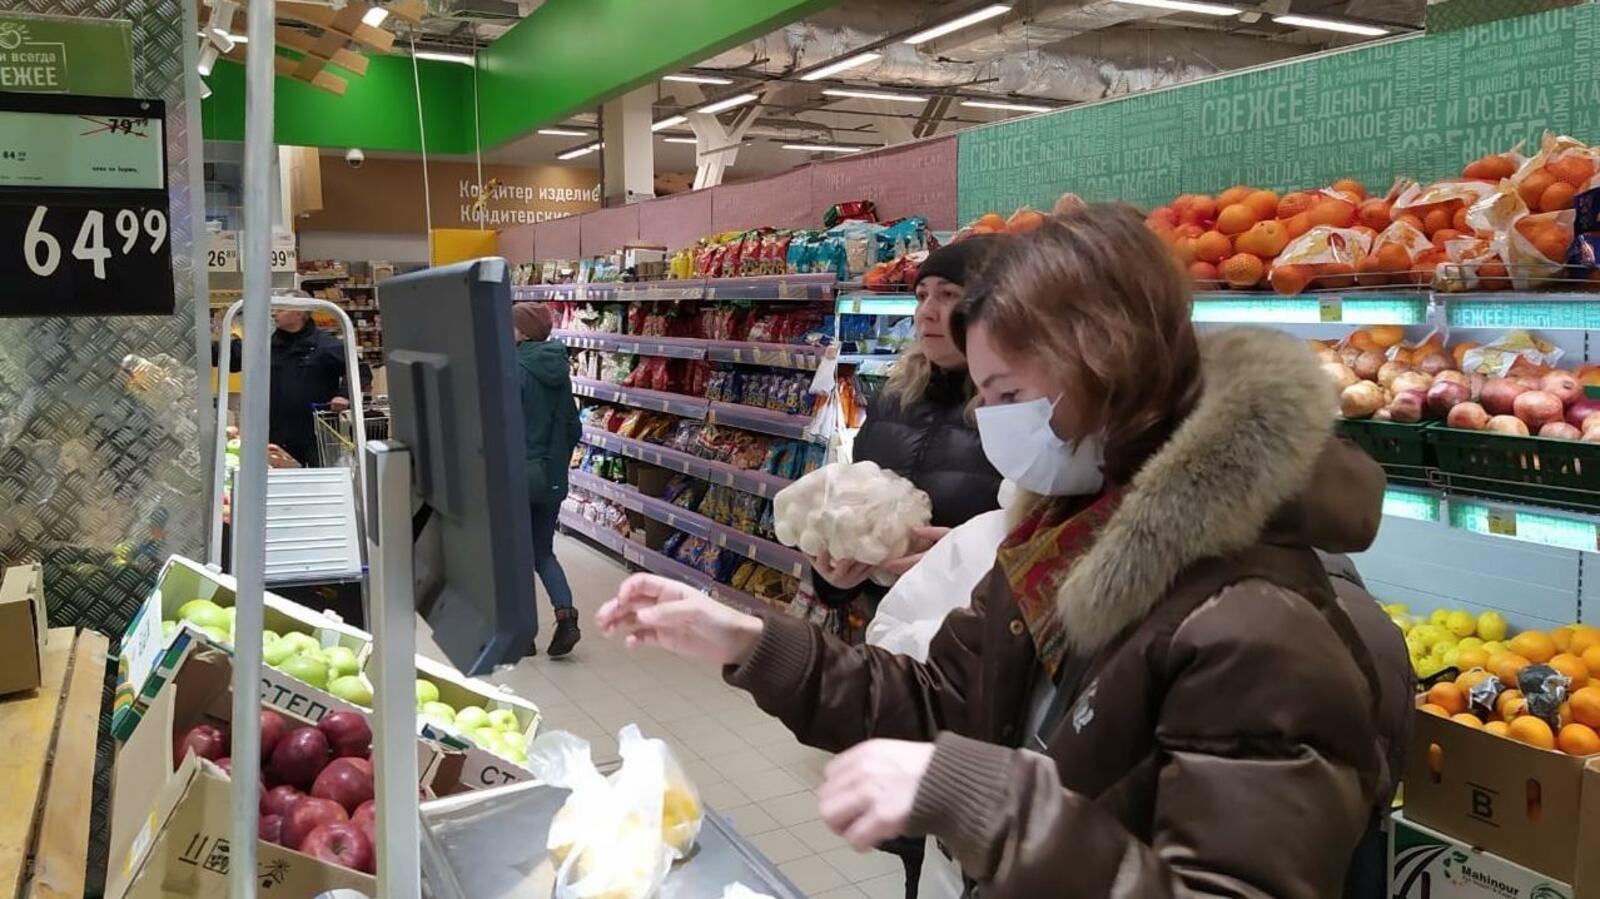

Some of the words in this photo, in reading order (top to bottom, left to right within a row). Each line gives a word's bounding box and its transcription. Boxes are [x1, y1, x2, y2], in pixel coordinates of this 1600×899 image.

[11, 53, 57, 64] всегда
[1201, 82, 1304, 137] СВЕЖЕЕ
[1318, 80, 1393, 119] ДЕНЬГИ
[1403, 103, 1438, 132] ВСЕ
[1446, 100, 1459, 126] И
[1467, 87, 1550, 124] ВСЕГДА
[1299, 111, 1387, 148] ВЫСОКОЕ
[970, 134, 1032, 174] СВЕЖЕЕ
[1125, 145, 1171, 170] ВСЕГДА
[481, 765, 522, 786] СТ
[1462, 865, 1520, 897] Mahinour
